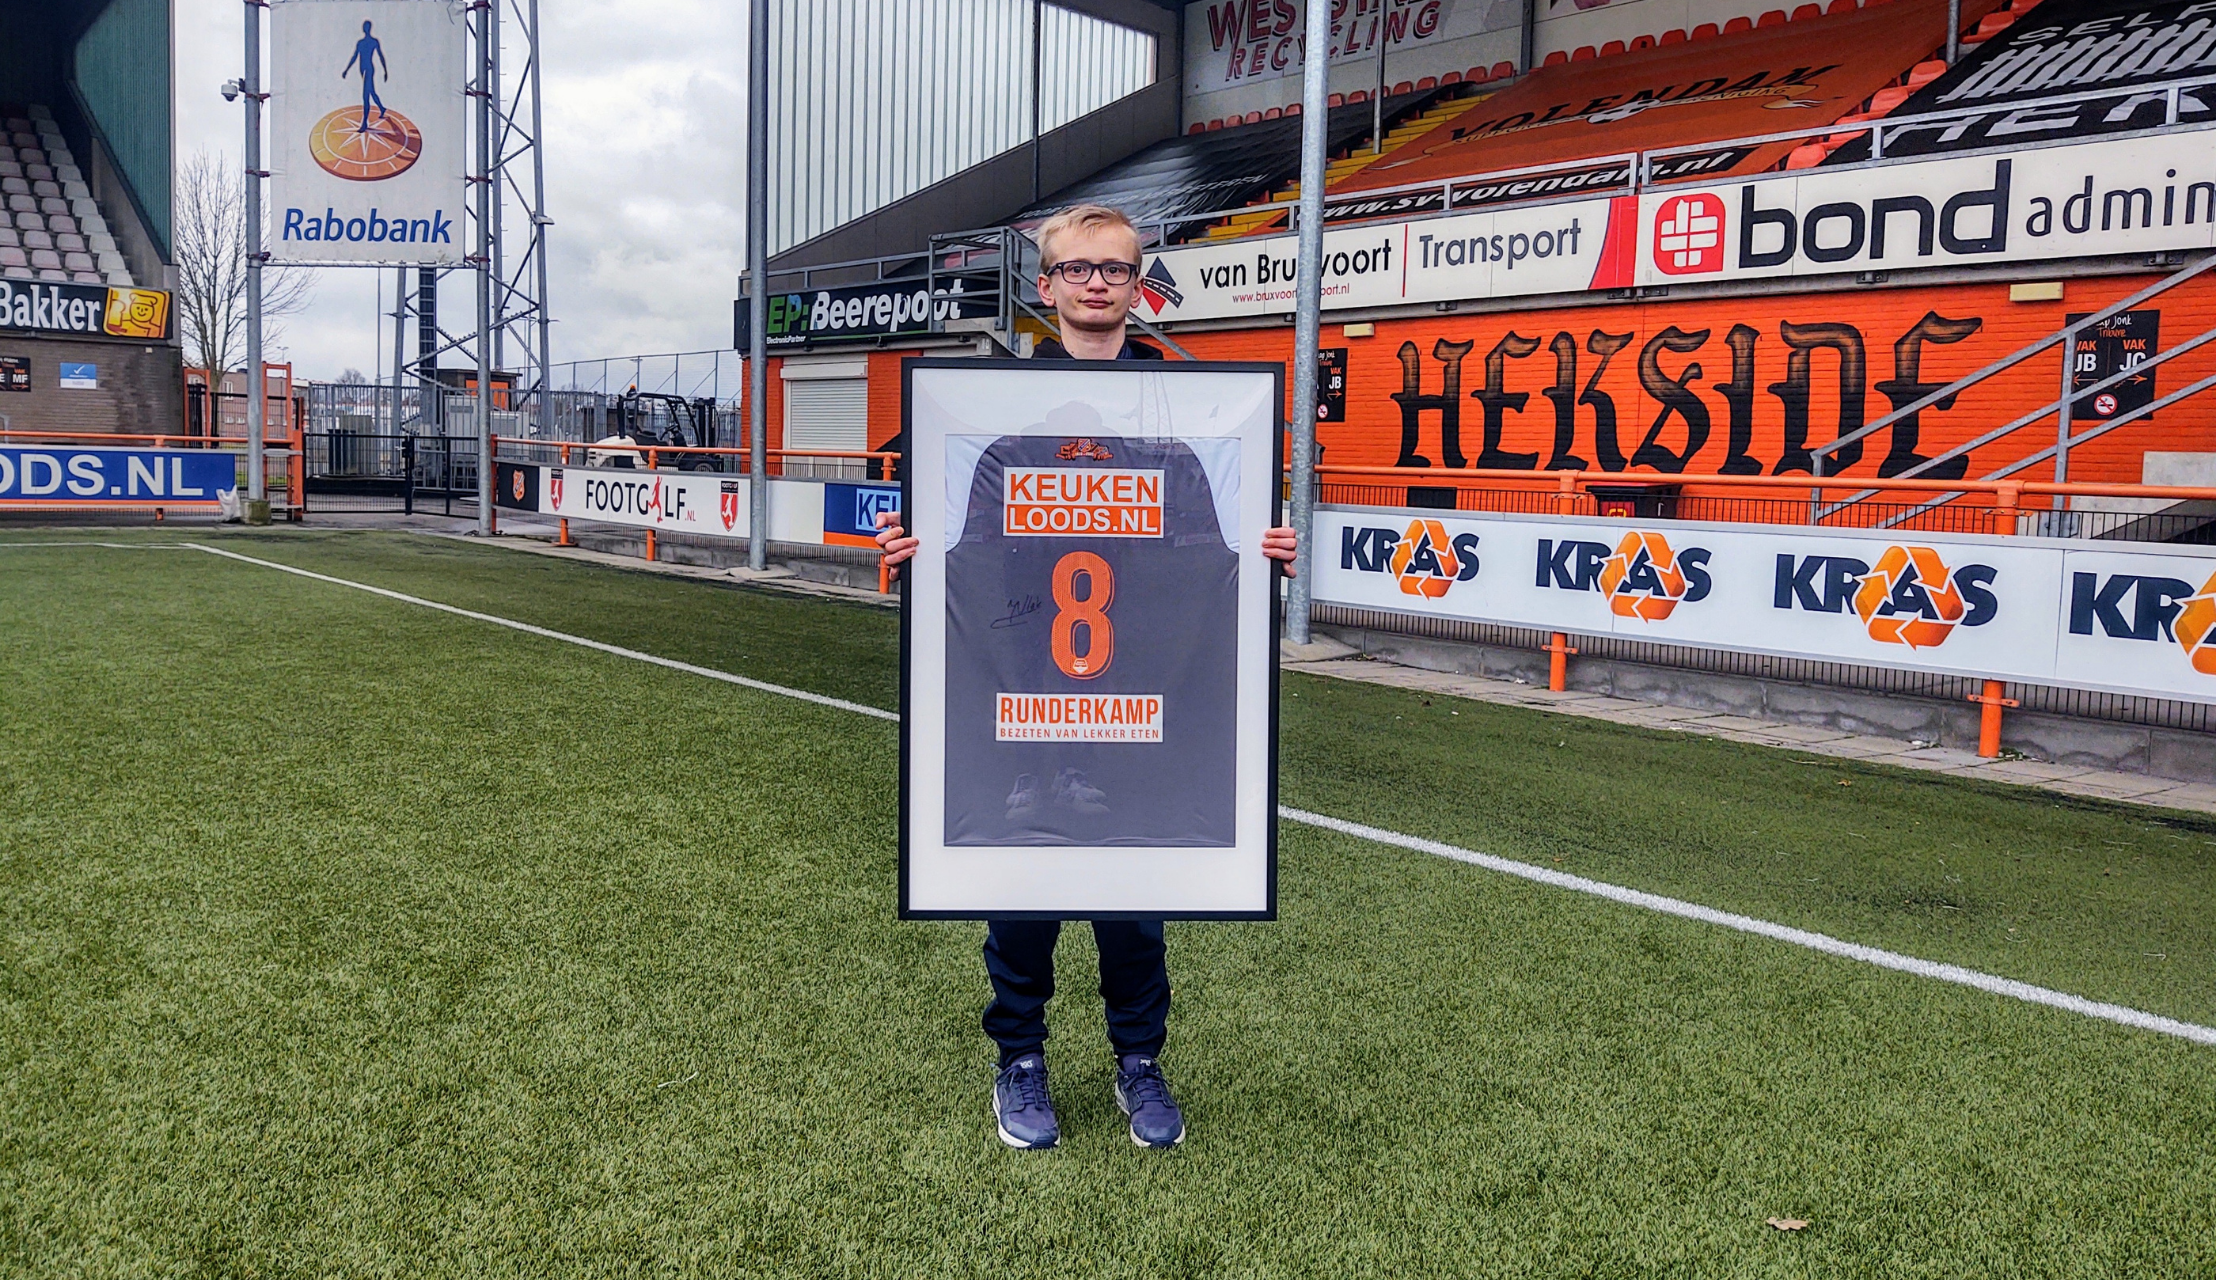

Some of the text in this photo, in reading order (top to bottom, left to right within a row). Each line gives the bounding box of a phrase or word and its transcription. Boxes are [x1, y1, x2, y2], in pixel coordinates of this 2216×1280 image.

[1225, 0, 1441, 81] RECLING
[1297, 151, 1735, 221] ww.sv-volenda.nl
[282, 207, 452, 243] Rabobank
[1739, 159, 2012, 269] bond
[1200, 239, 1392, 289] van Bruvoort
[1419, 218, 1581, 270] Transport
[0, 281, 100, 332] Bakker
[810, 279, 964, 332] Beerepoot
[2074, 353, 2097, 372] JB
[2122, 338, 2147, 350] VAK
[12, 374, 28, 383] MF
[1328, 376, 1342, 389] JB
[1010, 473, 1158, 503] KEUKEN
[1009, 507, 1158, 533] LOODS.NL
[1340, 526, 1480, 582] KRAS
[1536, 538, 1712, 603] KRAS
[1051, 551, 1114, 680] 8
[1774, 553, 1998, 627] KRAS
[2069, 571, 2216, 645] KR
[1000, 697, 1159, 725] RUNDERKAMP
[1000, 728, 1159, 739] BEZETEN VAN LEKKER ETEN
